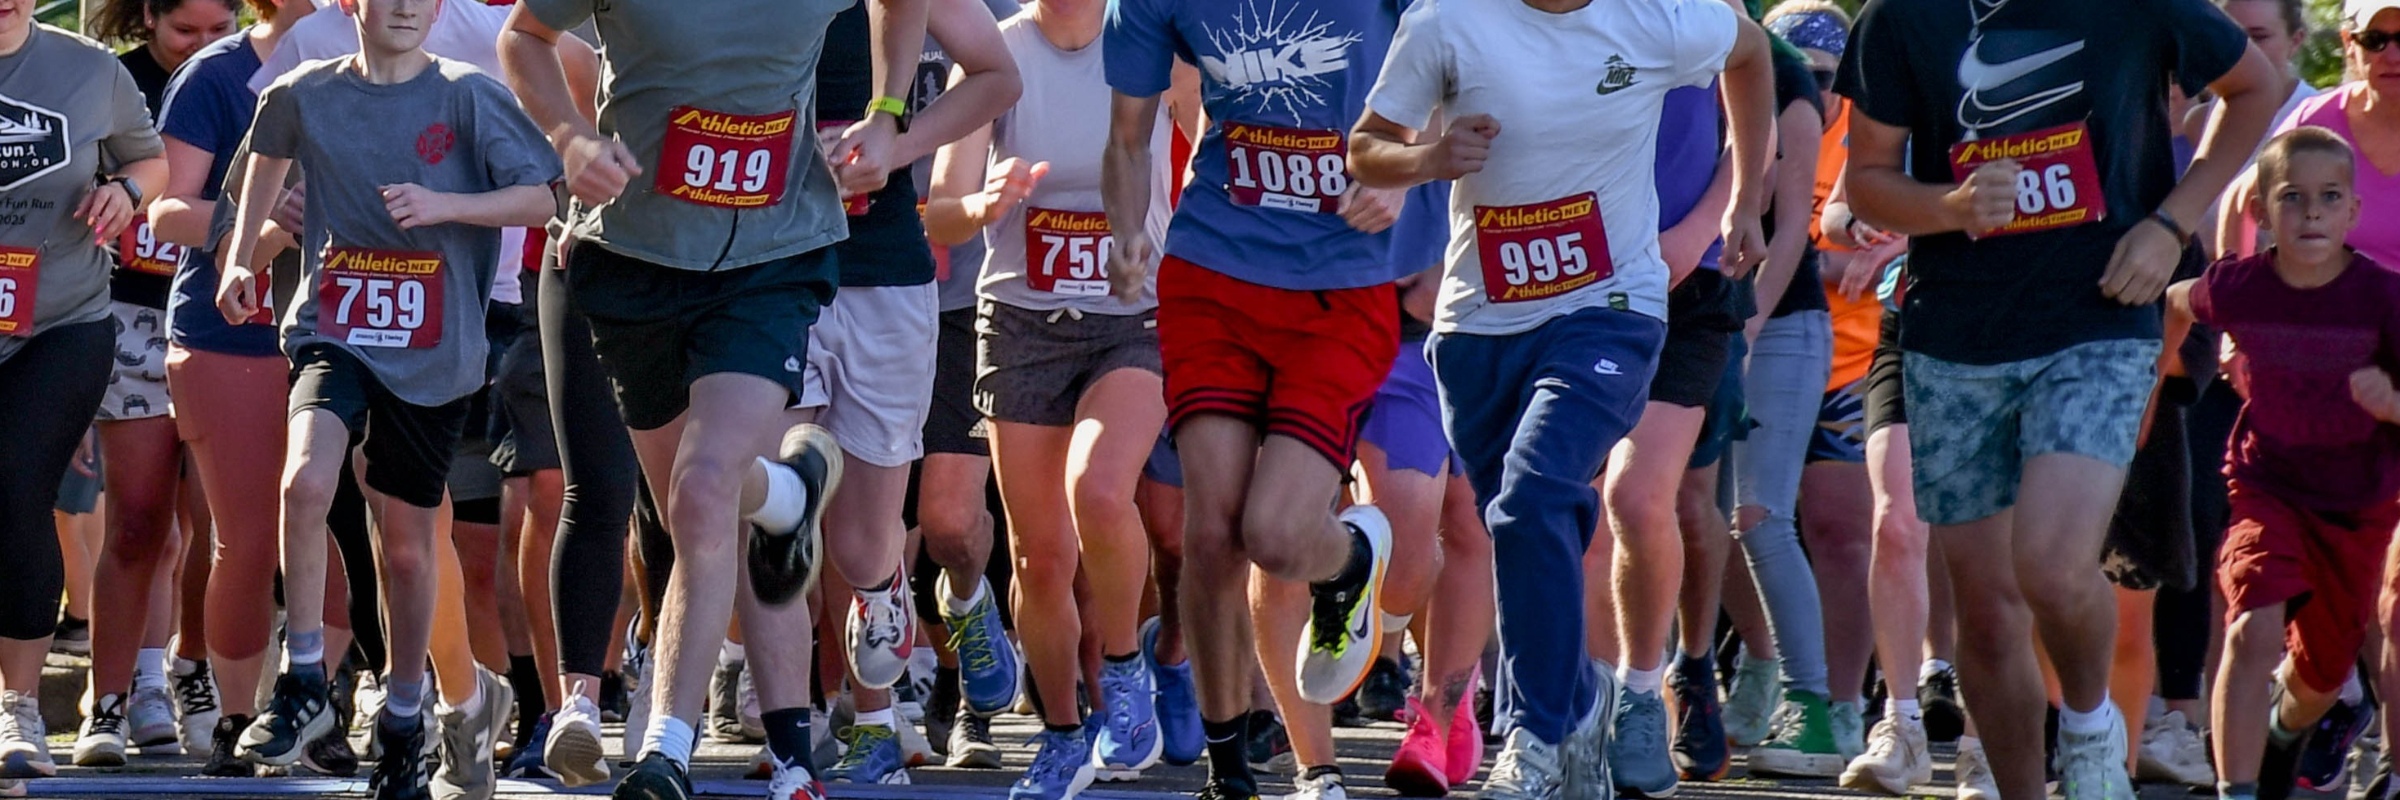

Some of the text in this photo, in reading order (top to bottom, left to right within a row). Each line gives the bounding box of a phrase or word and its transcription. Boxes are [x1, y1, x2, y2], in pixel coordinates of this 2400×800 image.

[684, 145, 770, 192] 919
[1231, 147, 1347, 196] 1088
[2016, 163, 2076, 214] 86
[6, 198, 55, 209] Fun Run
[136, 222, 177, 262] 92
[1500, 232, 1588, 285] 995
[336, 277, 425, 329] 759
